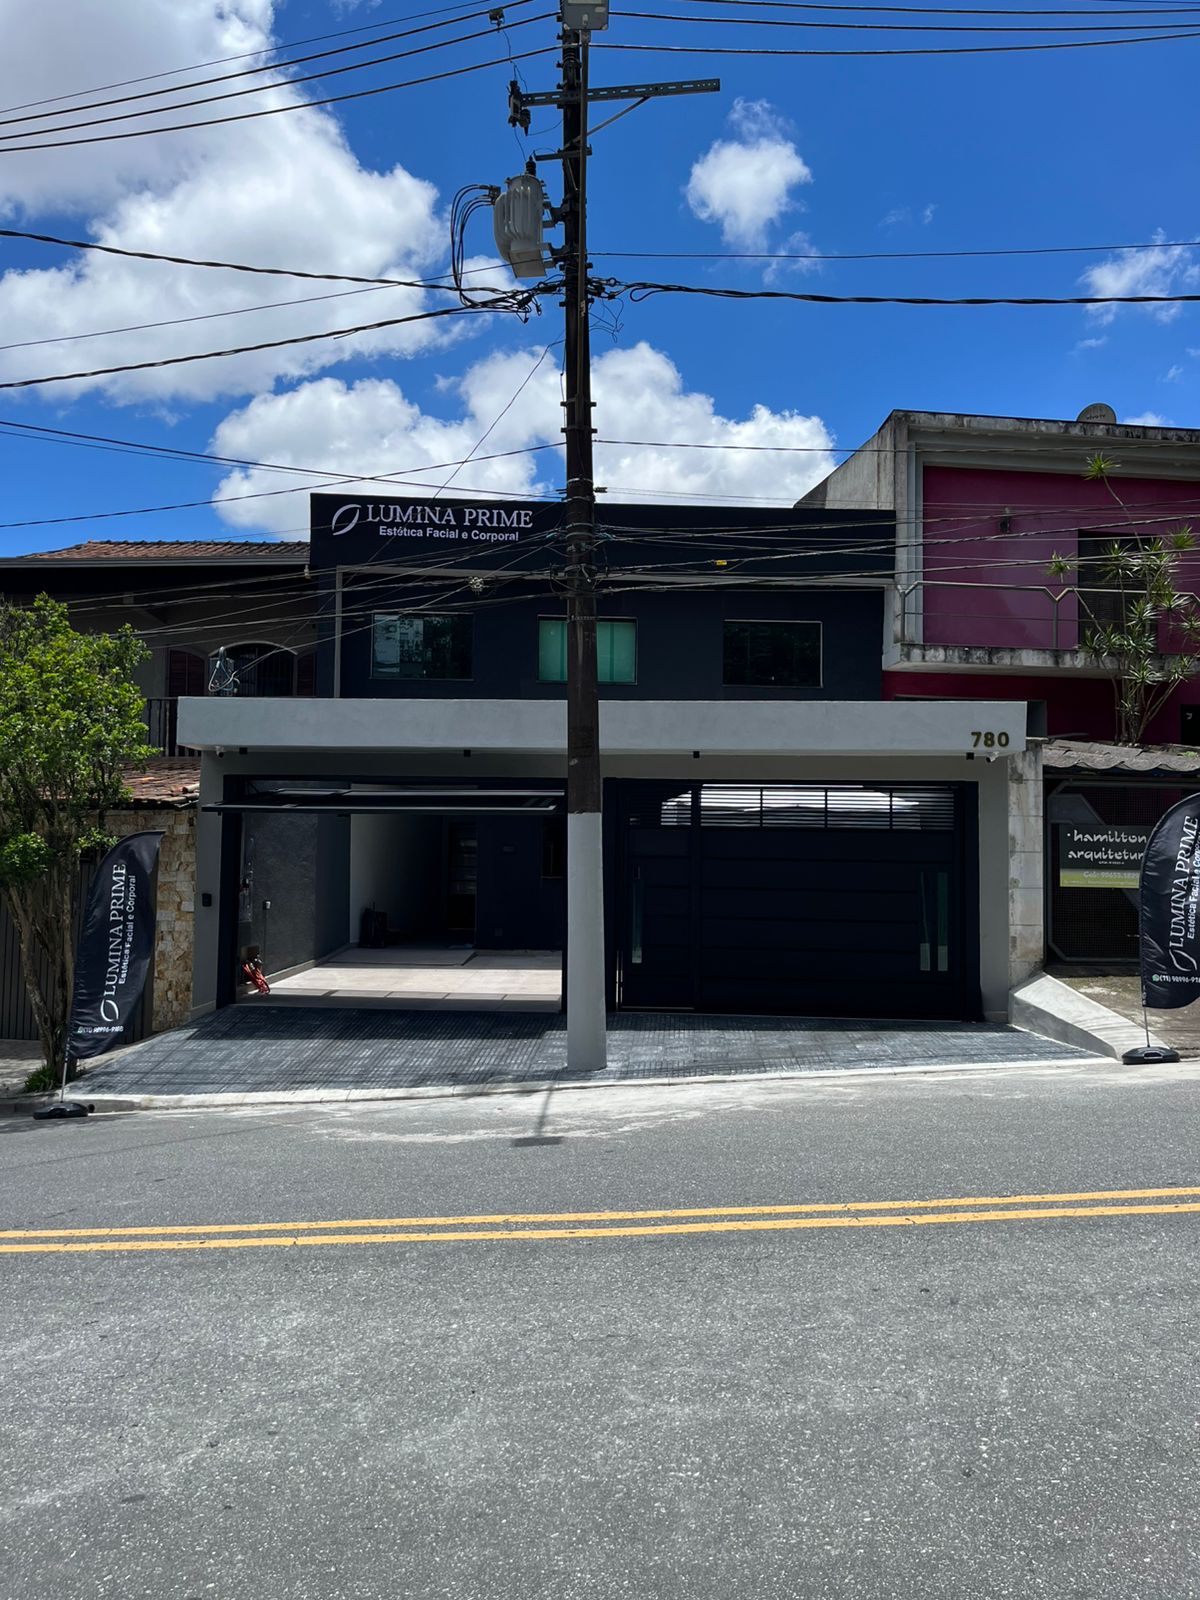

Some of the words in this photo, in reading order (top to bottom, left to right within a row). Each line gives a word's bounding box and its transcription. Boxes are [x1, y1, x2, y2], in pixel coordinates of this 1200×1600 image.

[366, 505, 456, 525] LUMINA
[463, 508, 533, 528] PRIME
[379, 526, 423, 537] Estética
[426, 527, 459, 539] Facial
[461, 532, 469, 540] e
[471, 530, 519, 543] Corporal
[971, 731, 1010, 748] 780
[1073, 829, 1147, 843] hamilton
[1175, 815, 1199, 874] PRIME
[1068, 847, 1144, 862] arquitetur
[109, 863, 126, 922] PRIME
[126, 875, 137, 912] Corporal
[1189, 876, 1200, 902] Facial
[1169, 876, 1189, 948] LUMINA
[1187, 903, 1197, 939] Estética
[124, 922, 135, 948] Facial
[103, 924, 124, 997] LUMINA
[118, 949, 130, 985] Estética
